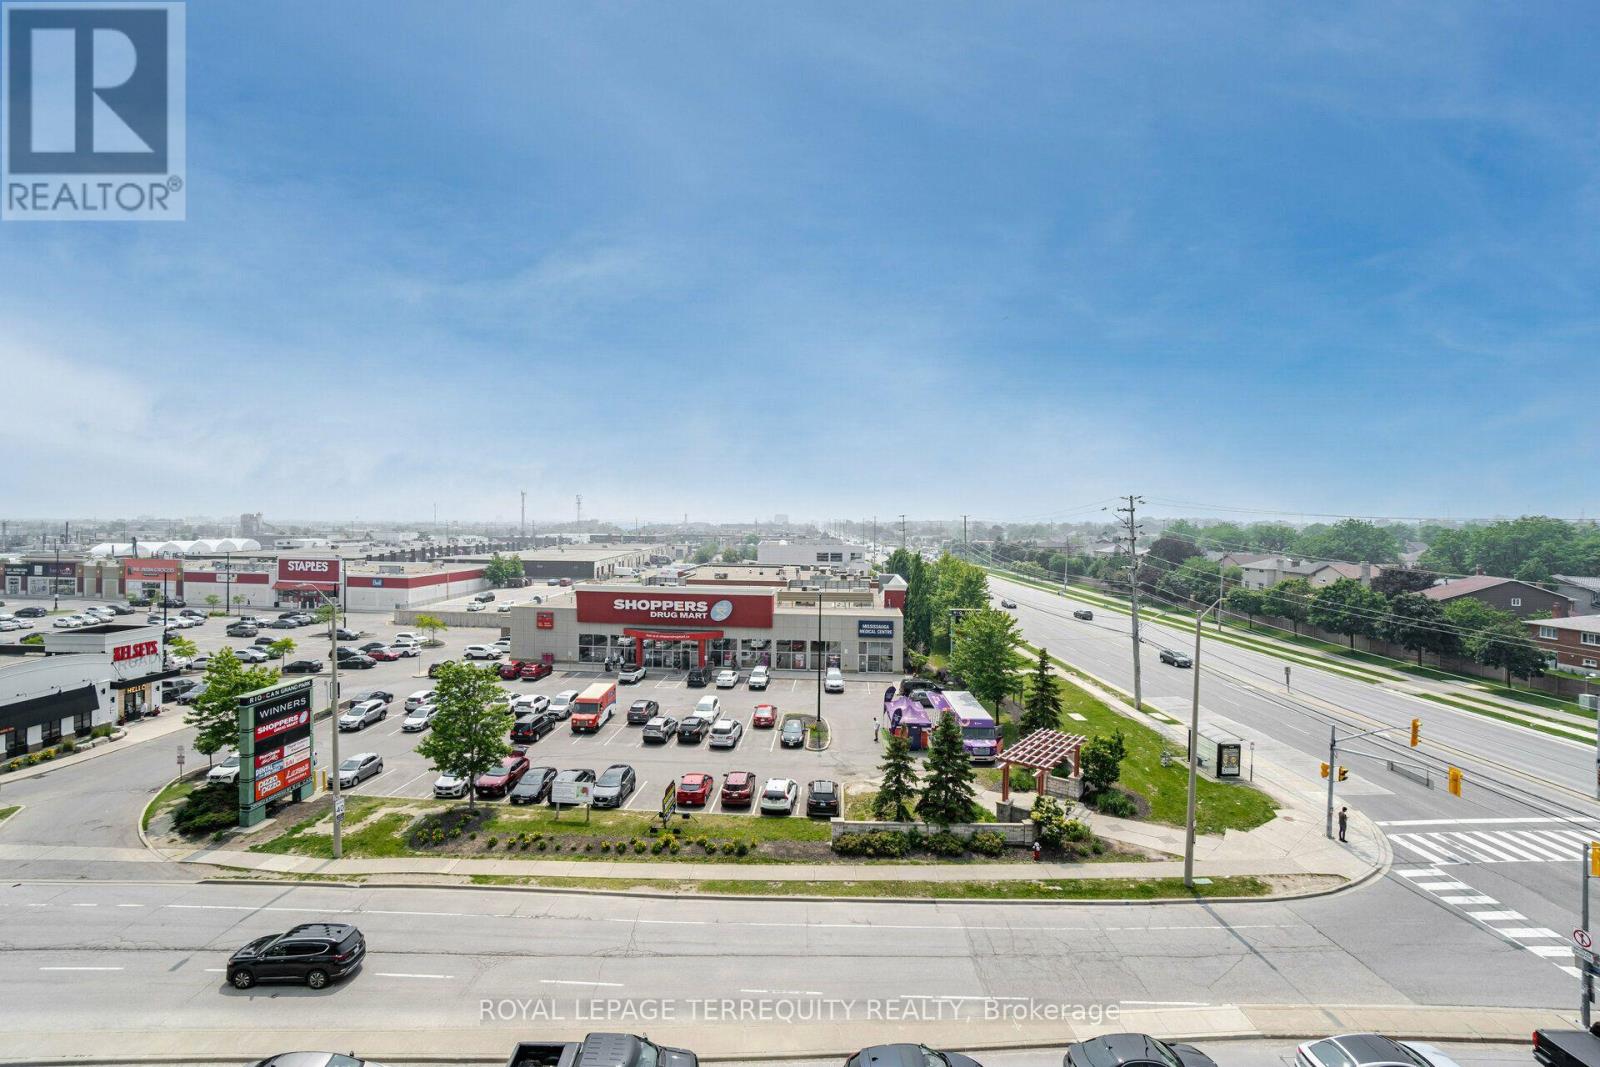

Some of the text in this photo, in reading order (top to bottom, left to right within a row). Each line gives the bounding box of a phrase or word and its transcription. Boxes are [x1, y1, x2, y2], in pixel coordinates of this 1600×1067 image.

[287, 561, 329, 572] STAPLES
[613, 599, 708, 612] SHOPPERS
[113, 640, 158, 662] KELSEYS
[127, 684, 147, 694] HELLO
[259, 697, 307, 719] WINNERS
[257, 714, 299, 734] SHOPPERS
